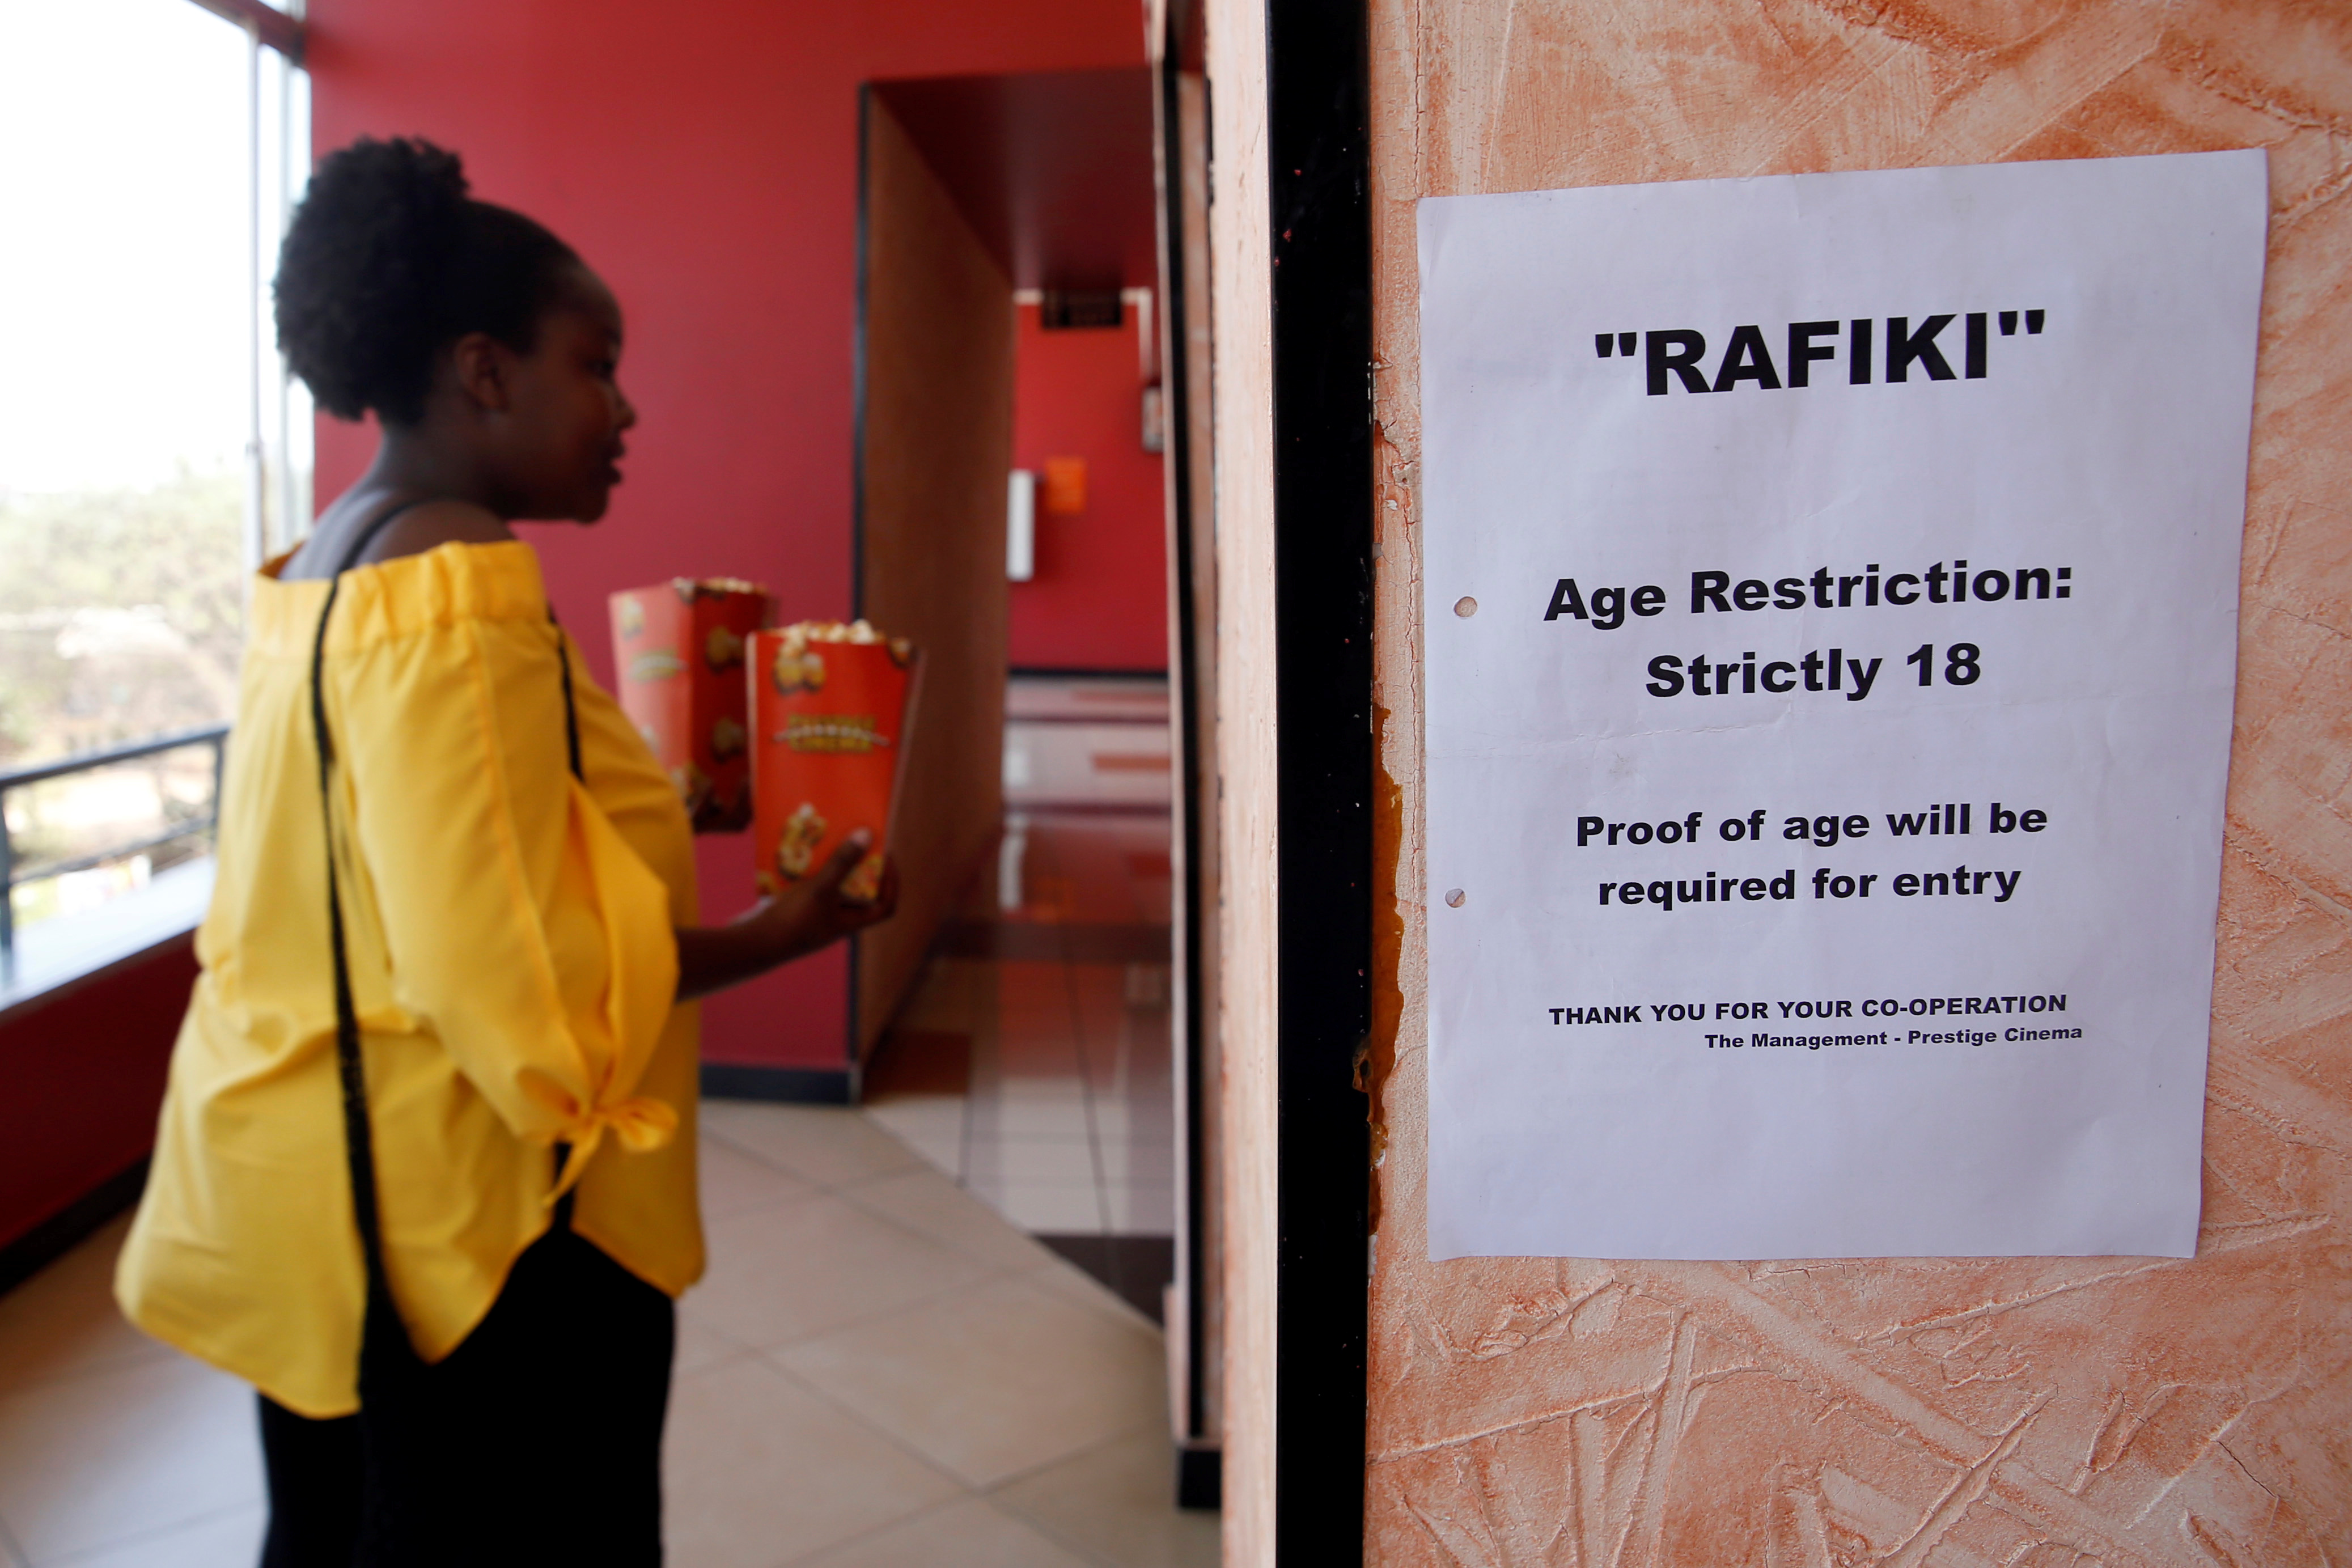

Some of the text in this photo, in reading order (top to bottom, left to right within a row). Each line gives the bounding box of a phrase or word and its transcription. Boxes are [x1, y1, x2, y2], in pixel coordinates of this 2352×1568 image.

[1543, 560, 2071, 630] Age Restriction:
[1646, 642, 1981, 701] Strictly 18
[1577, 802, 2048, 847] Proof of age will be
[1599, 864, 2022, 912] required for entry
[1548, 994, 2067, 1025] THANK YOU FOR YOUR CO-OPERATION
[1704, 1034, 1744, 1048] The
[1752, 1031, 1888, 1050] Management
[1908, 1029, 1997, 1046] Prestige
[2004, 1027, 2082, 1042] Cinema
